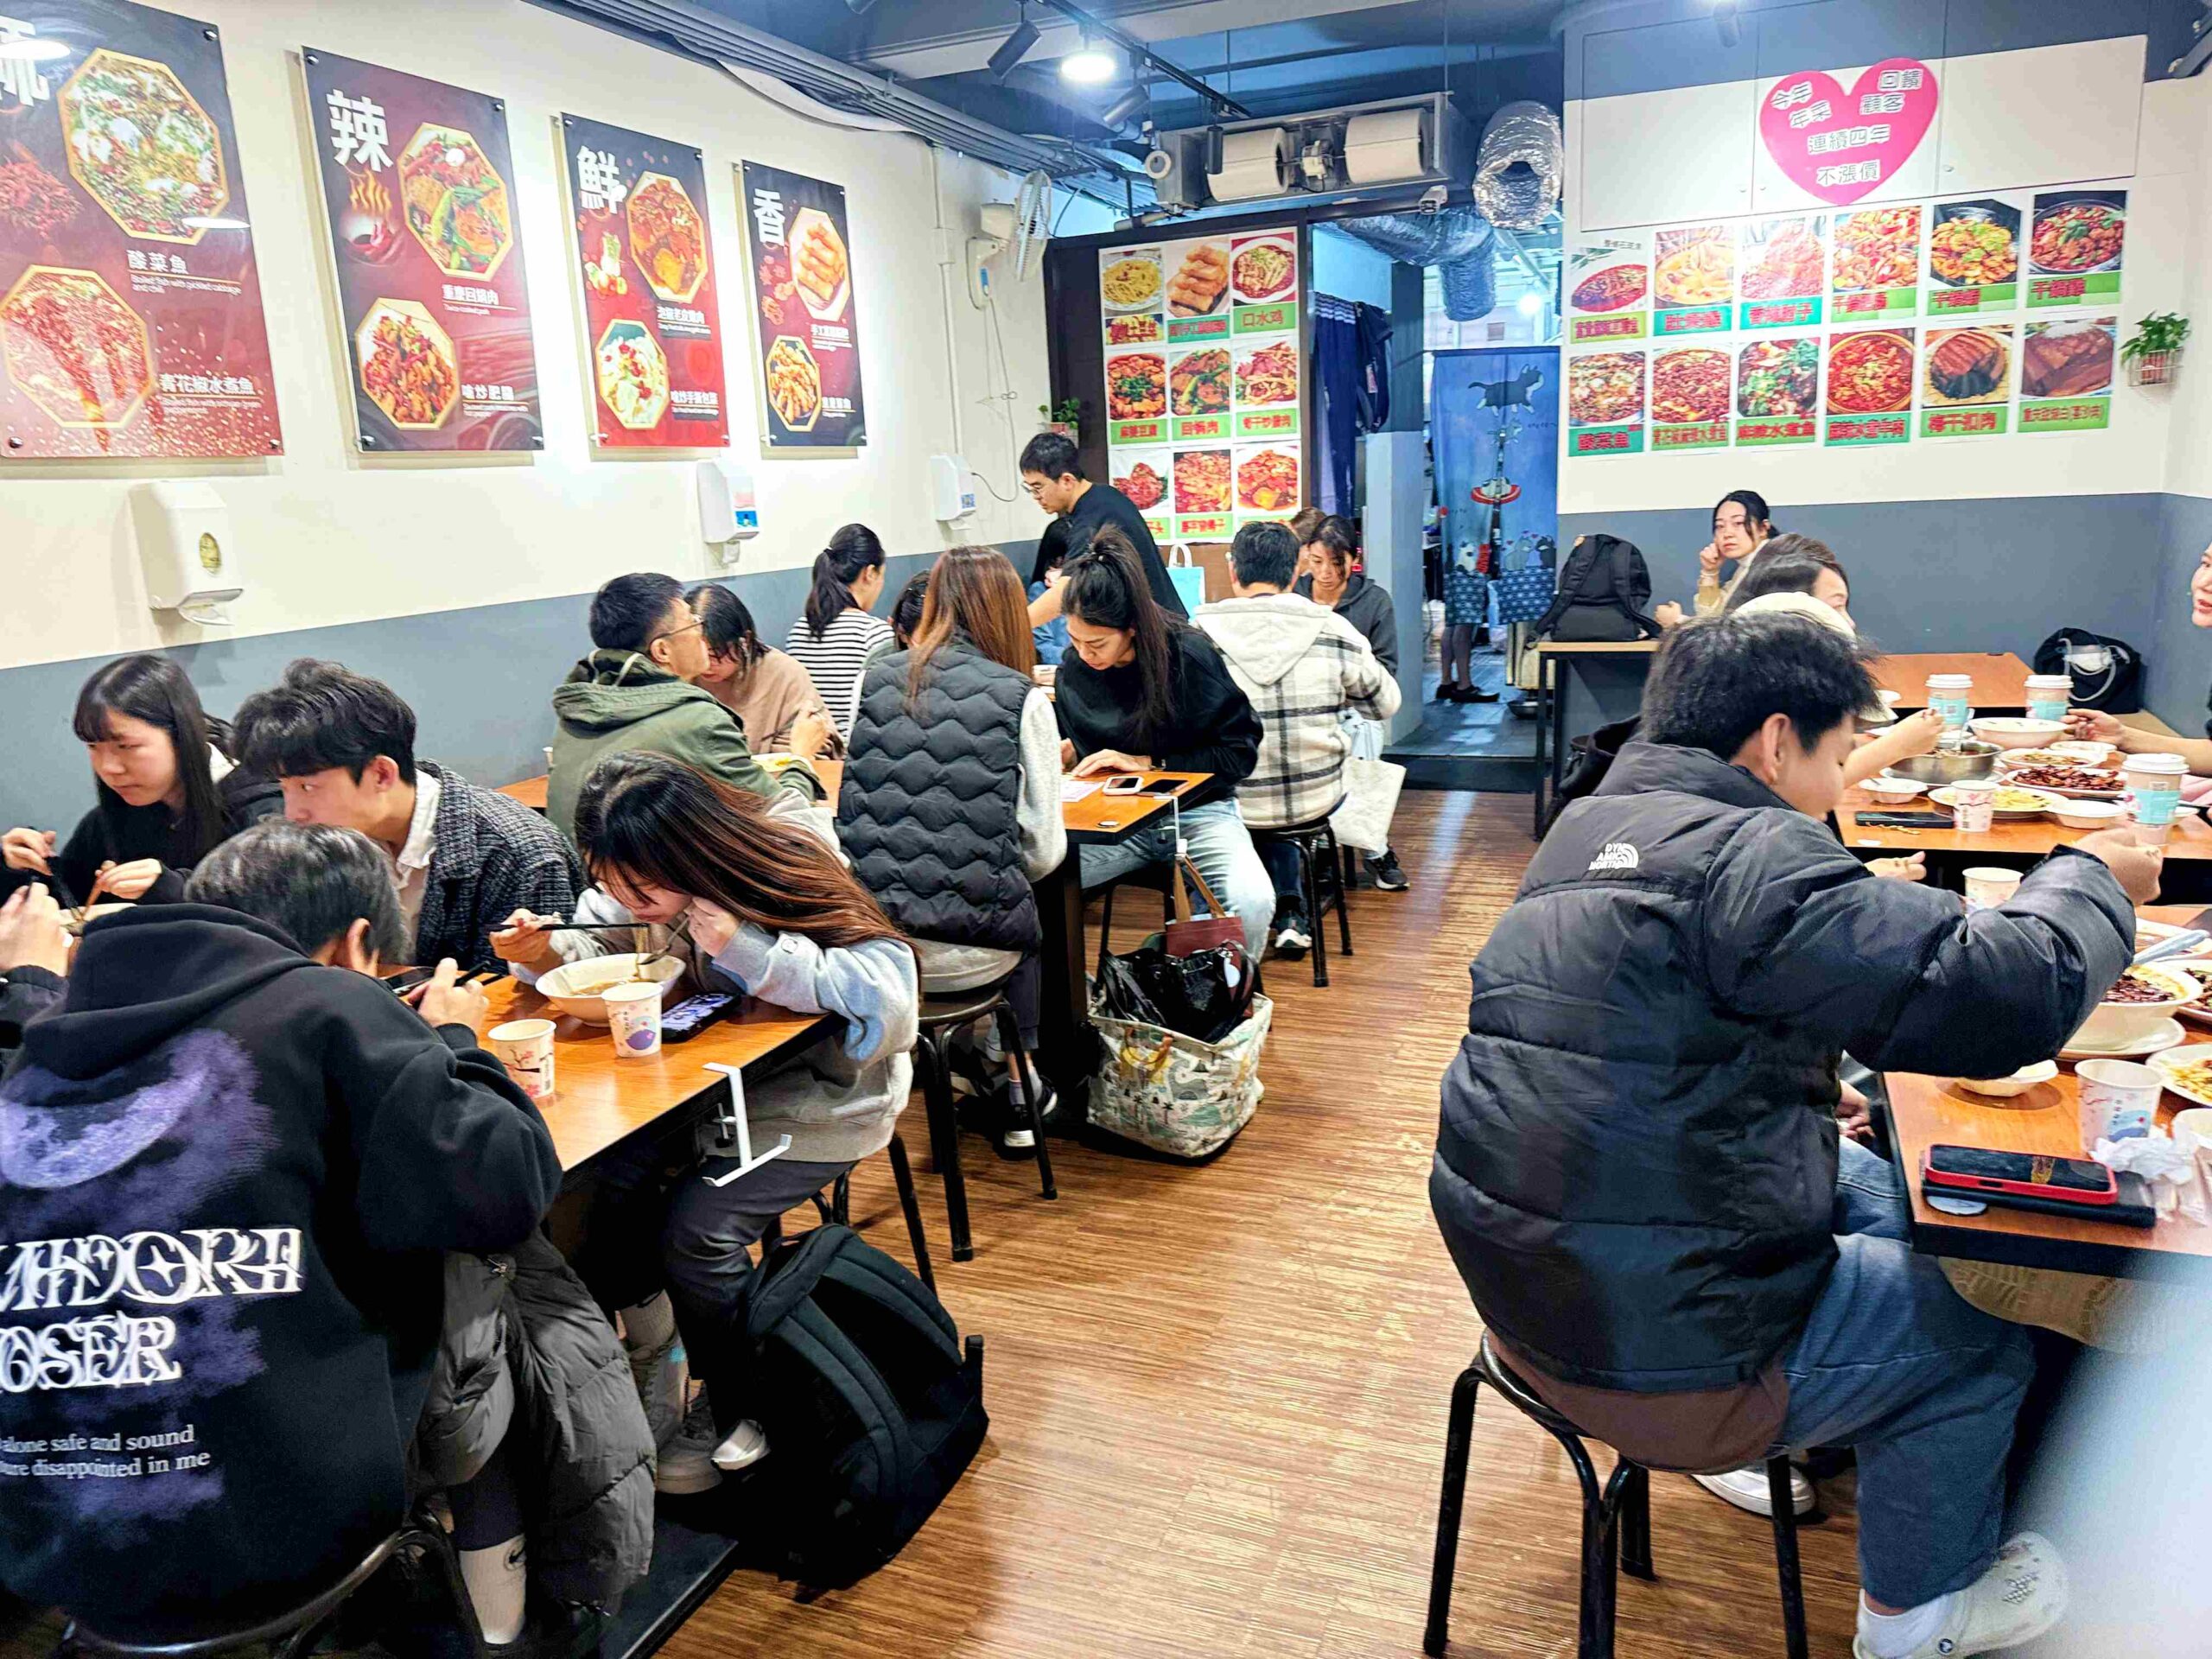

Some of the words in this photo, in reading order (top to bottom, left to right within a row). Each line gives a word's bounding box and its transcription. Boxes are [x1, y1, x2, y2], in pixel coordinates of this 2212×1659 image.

[326, 88, 394, 172] 辣
[1808, 125, 1890, 154] 連續四年
[576, 145, 626, 214] 鮮
[1817, 161, 1879, 186] 不漲價
[753, 188, 785, 246] 香
[126, 249, 189, 275] 酸菜魚
[1243, 309, 1283, 327] 口水鸡
[159, 373, 256, 396] 青花椒水煮魚
[50, 1433, 87, 1452] safe
[90, 1433, 121, 1452] and
[125, 1424, 195, 1451] sound
[31, 1457, 143, 1480] disappointed
[148, 1456, 170, 1474] in
[175, 1452, 211, 1470] me
